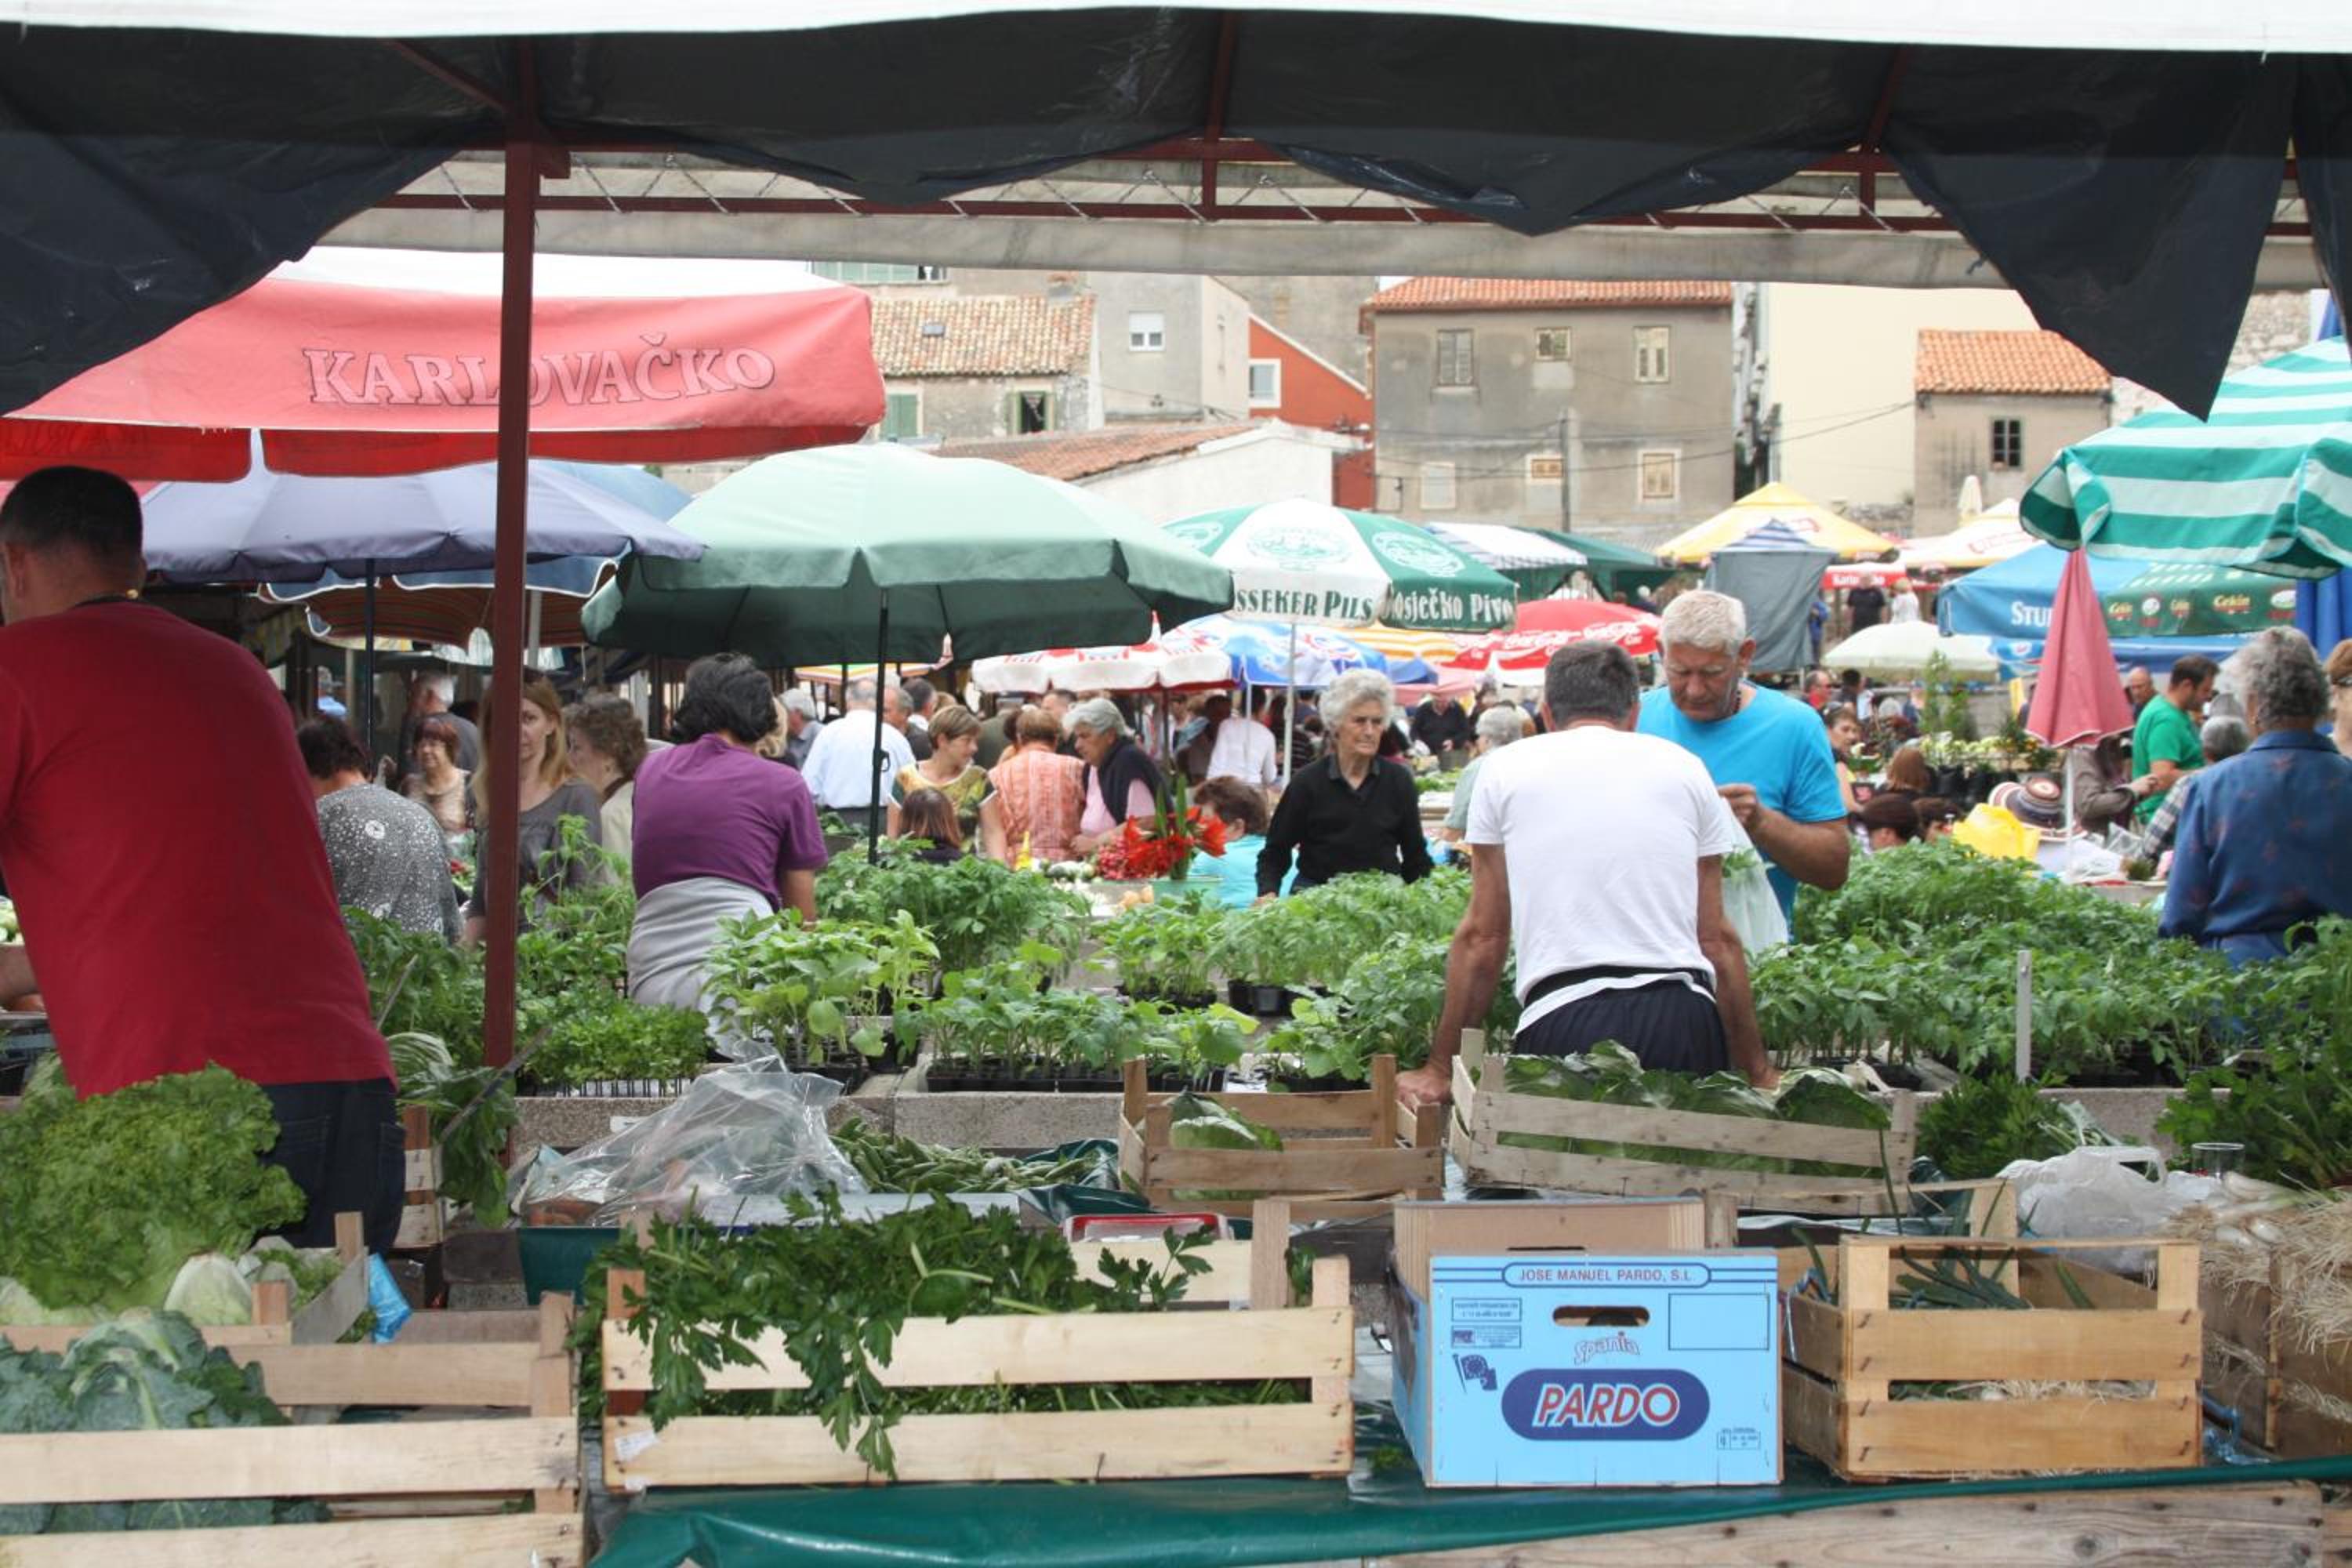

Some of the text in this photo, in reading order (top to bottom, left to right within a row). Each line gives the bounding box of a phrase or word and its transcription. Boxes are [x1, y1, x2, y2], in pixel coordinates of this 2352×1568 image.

[1236, 589, 1317, 616] SSEKER
[1470, 593, 1513, 622] Pivo
[1521, 1269, 1553, 1280] JOSE
[1558, 1269, 1612, 1280] MANUEL
[1617, 1269, 1666, 1283] PARDO,
[1532, 1382, 1680, 1428] PARDO
